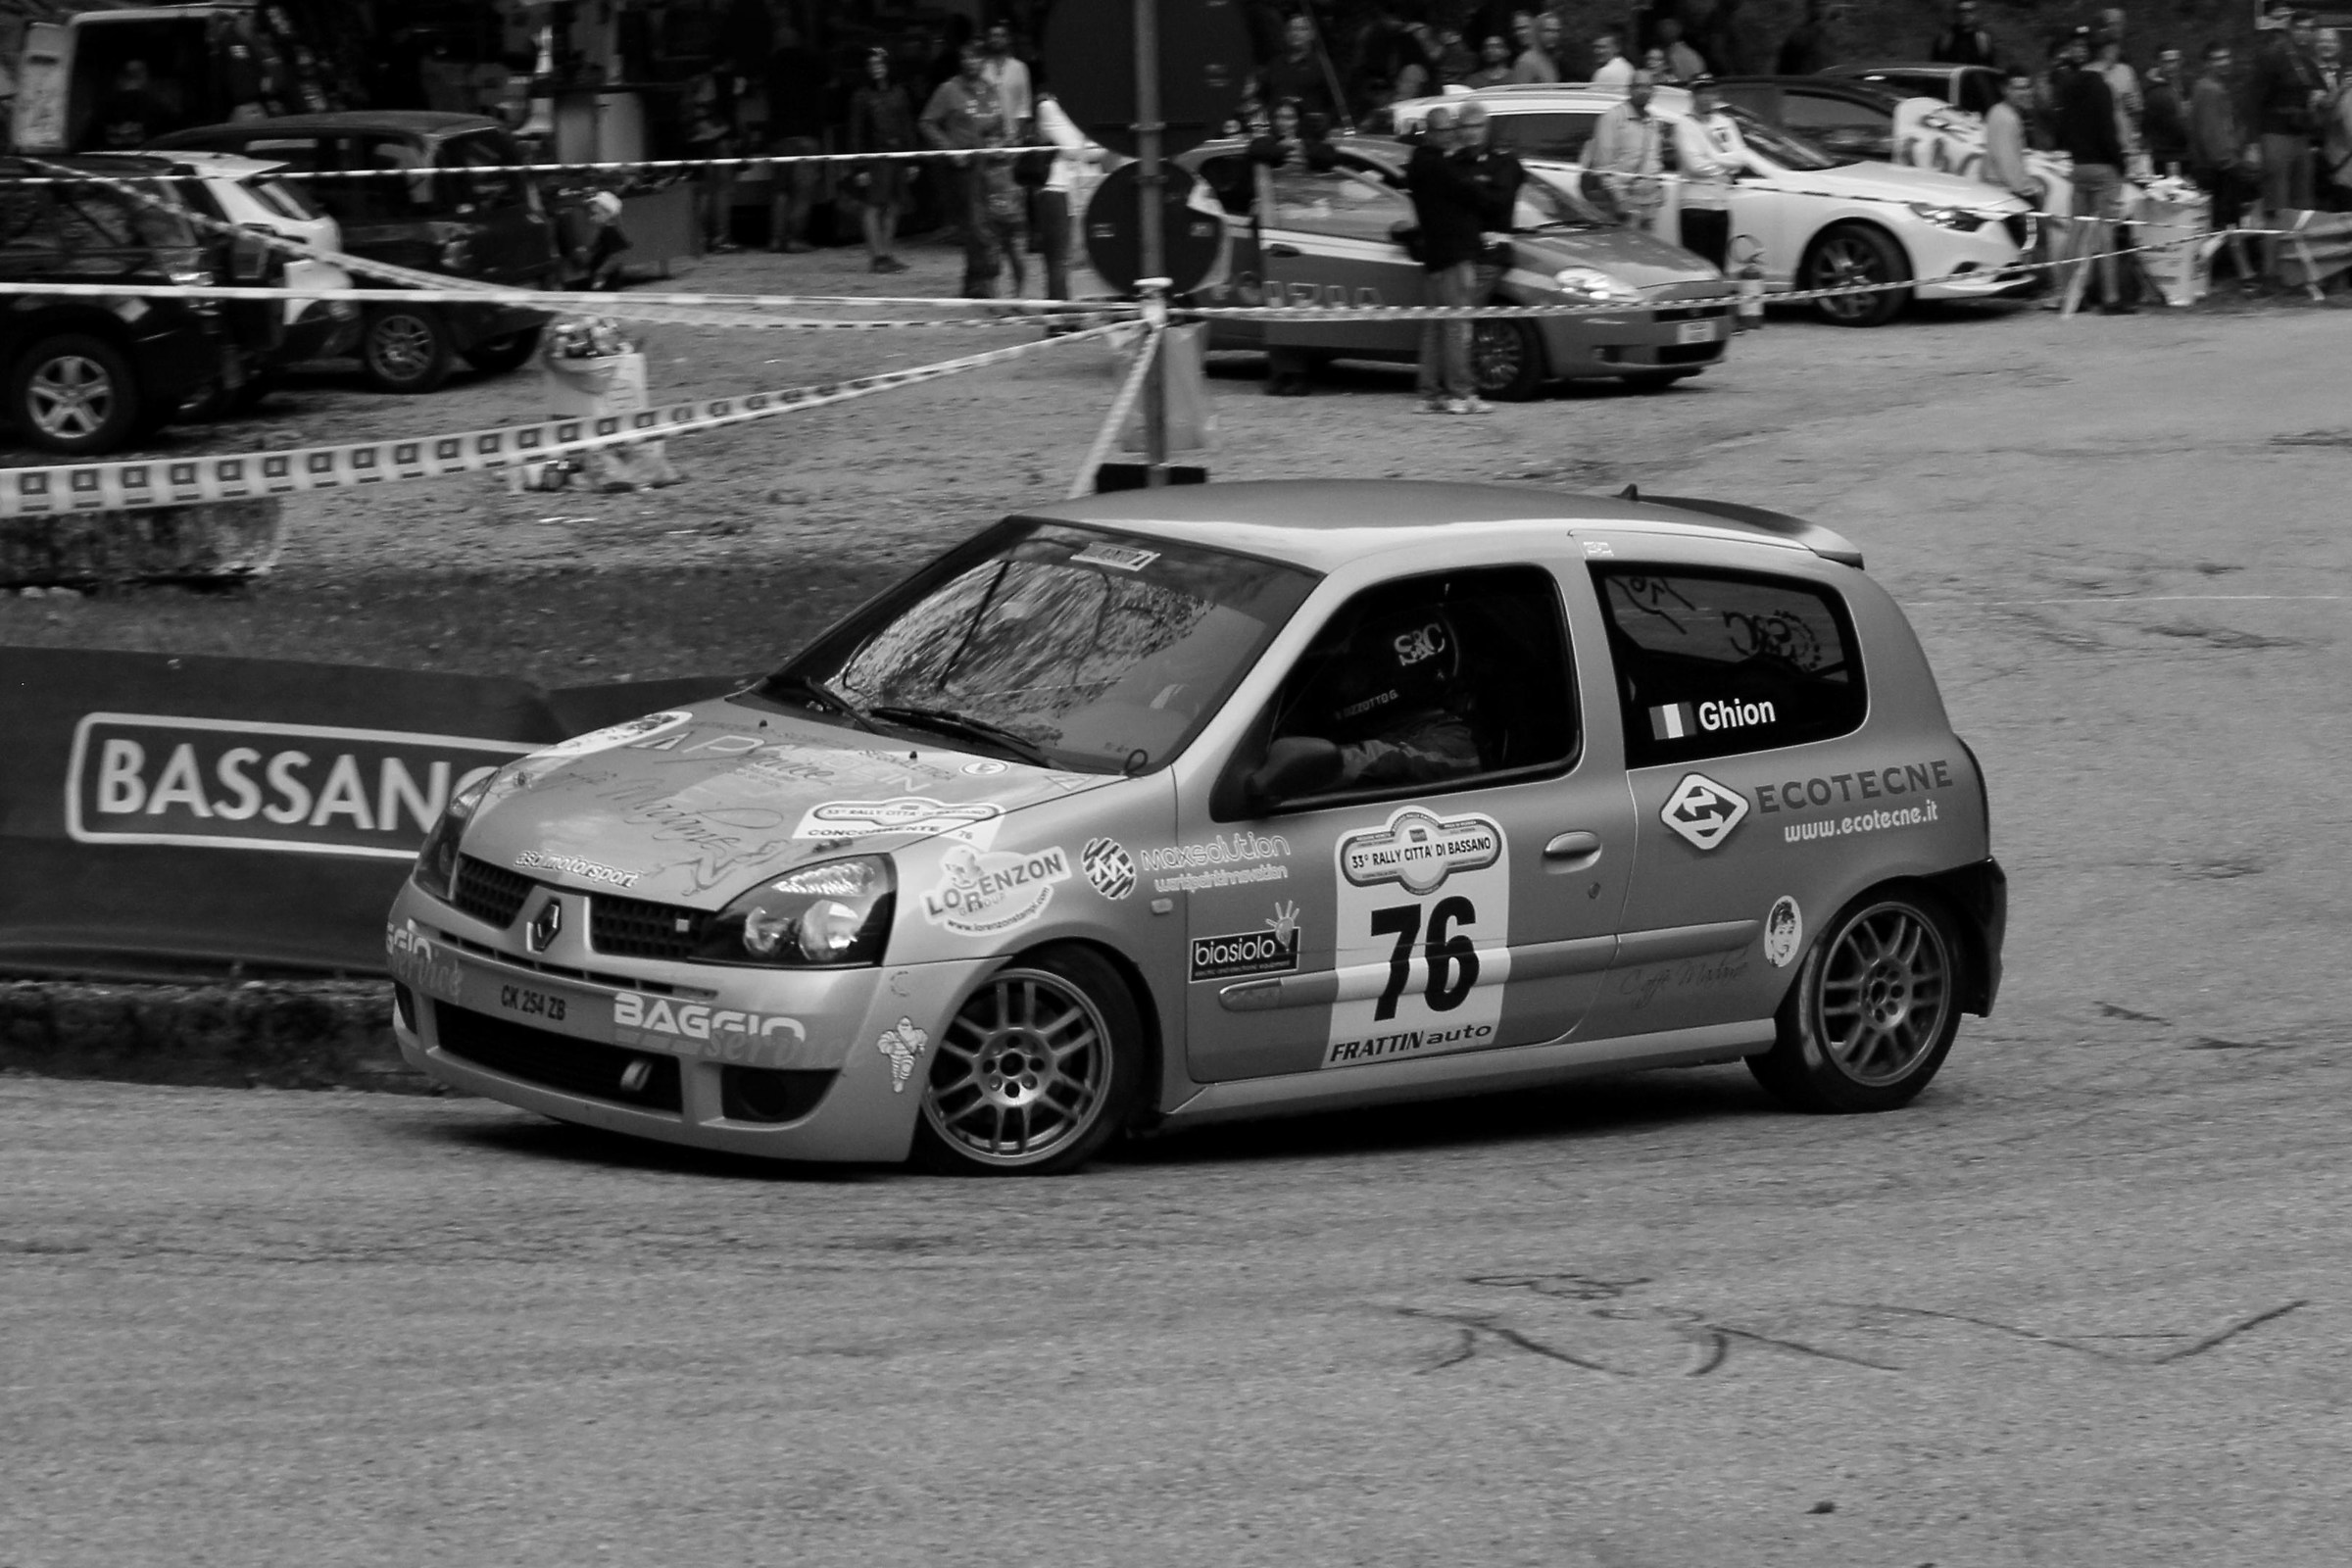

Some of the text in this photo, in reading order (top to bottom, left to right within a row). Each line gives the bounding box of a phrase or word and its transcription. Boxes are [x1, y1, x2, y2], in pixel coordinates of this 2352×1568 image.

[1698, 697, 1777, 731] Ghion
[97, 738, 500, 833] BASSAN
[1755, 760, 1954, 815] ECOTECNE
[958, 830, 974, 841] 76
[1784, 799, 1939, 843] www.ecotecne.it
[1373, 849, 1402, 866] RALLY
[1436, 845, 1446, 856] DI
[1448, 837, 1492, 855] BASSANO
[542, 854, 638, 889] motorsport
[926, 854, 1063, 916] LORENZON
[1195, 935, 1276, 966] biasiolo
[1370, 894, 1481, 1022] 76
[501, 984, 567, 1021] CK 254 ZB
[613, 992, 806, 1043] BAGGIO
[1330, 1024, 1493, 1063] FRATTIN auto
